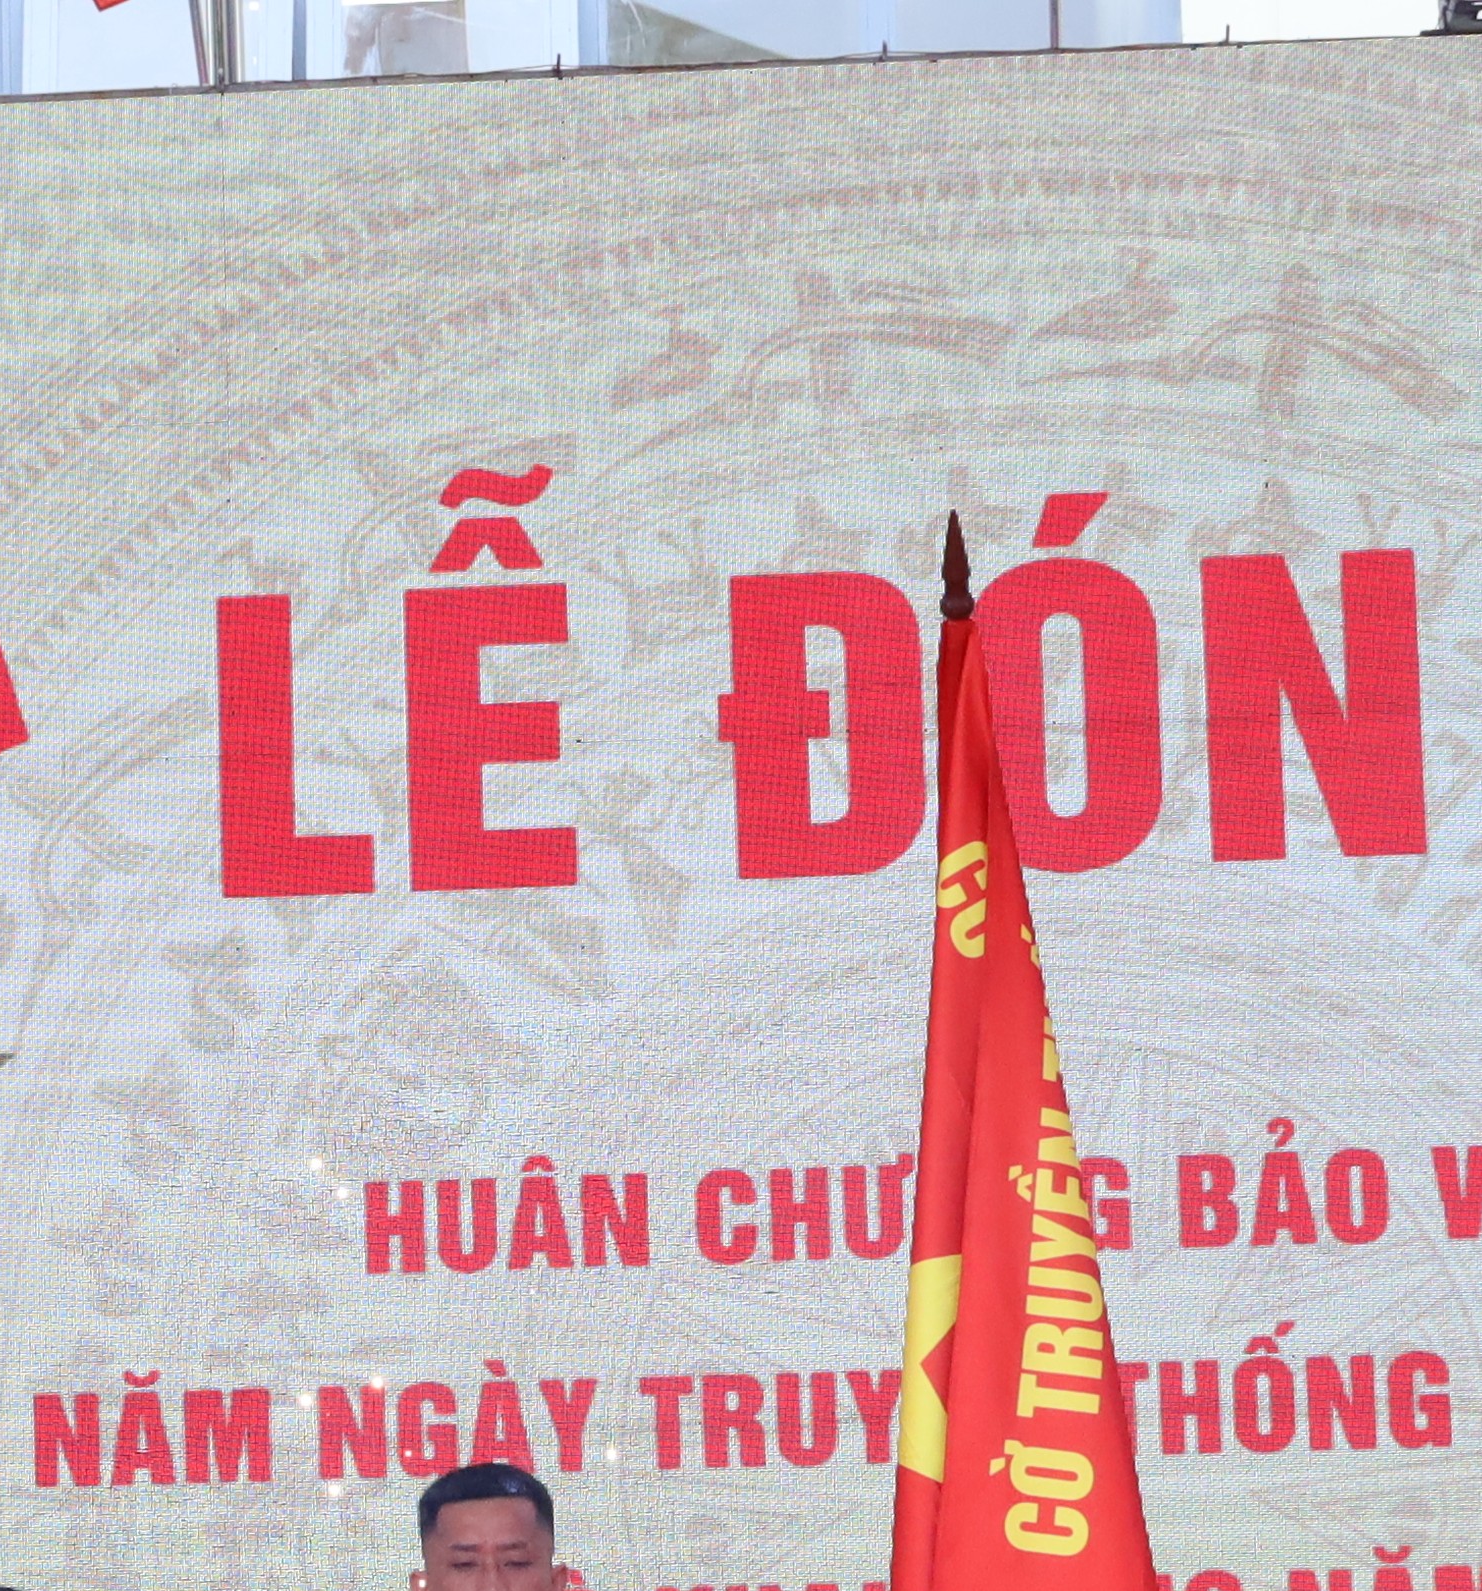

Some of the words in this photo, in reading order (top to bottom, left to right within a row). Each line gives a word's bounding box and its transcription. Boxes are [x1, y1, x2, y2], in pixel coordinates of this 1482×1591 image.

[217, 464, 579, 898] LỄ
[718, 491, 1428, 880] ĐÓN
[366, 1155, 650, 1274] HUÂN
[696, 1153, 1132, 1265] CHƯG
[1178, 1118, 1388, 1248] BẢO
[34, 1370, 272, 1488] NĂM
[318, 1360, 597, 1479] NGÀY
[640, 1370, 903, 1470] TRUY
[988, 1438, 1095, 1557] CỜ
